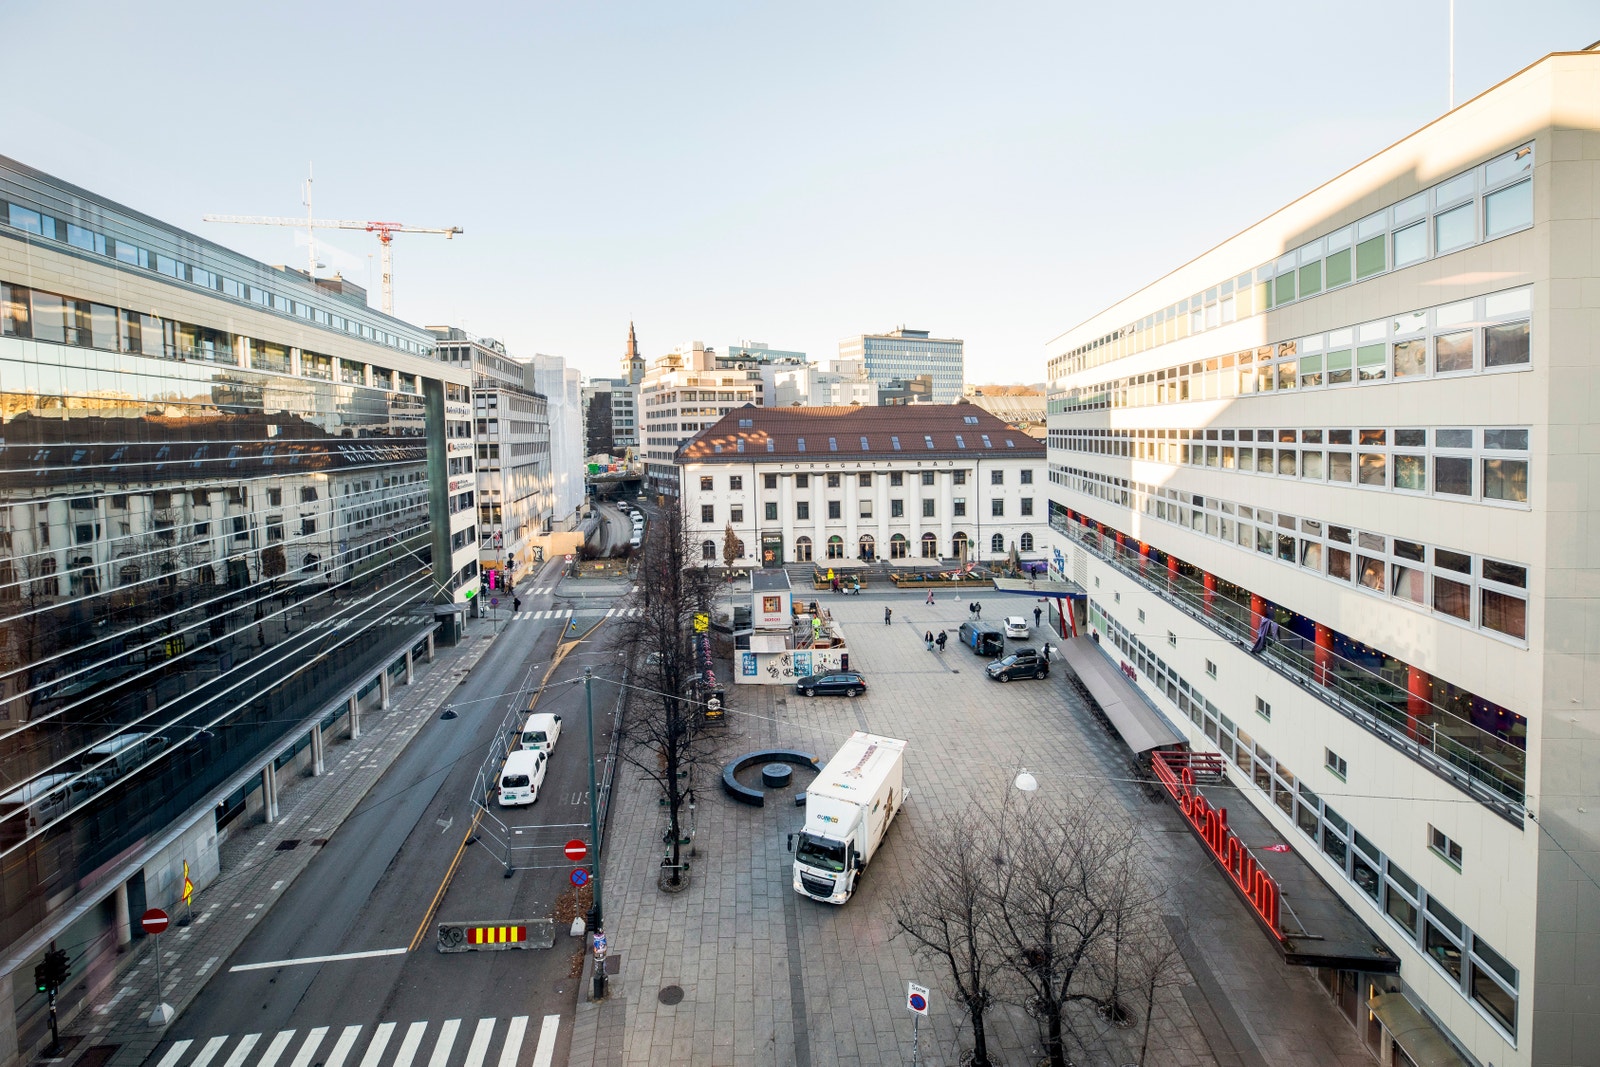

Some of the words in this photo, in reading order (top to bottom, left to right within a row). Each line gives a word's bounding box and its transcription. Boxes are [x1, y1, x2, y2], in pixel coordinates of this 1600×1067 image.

[779, 462, 892, 470] TORGGATA
[917, 460, 954, 468] BAD
[1180, 767, 1282, 931] Sentrum
[911, 984, 927, 995] Sone
